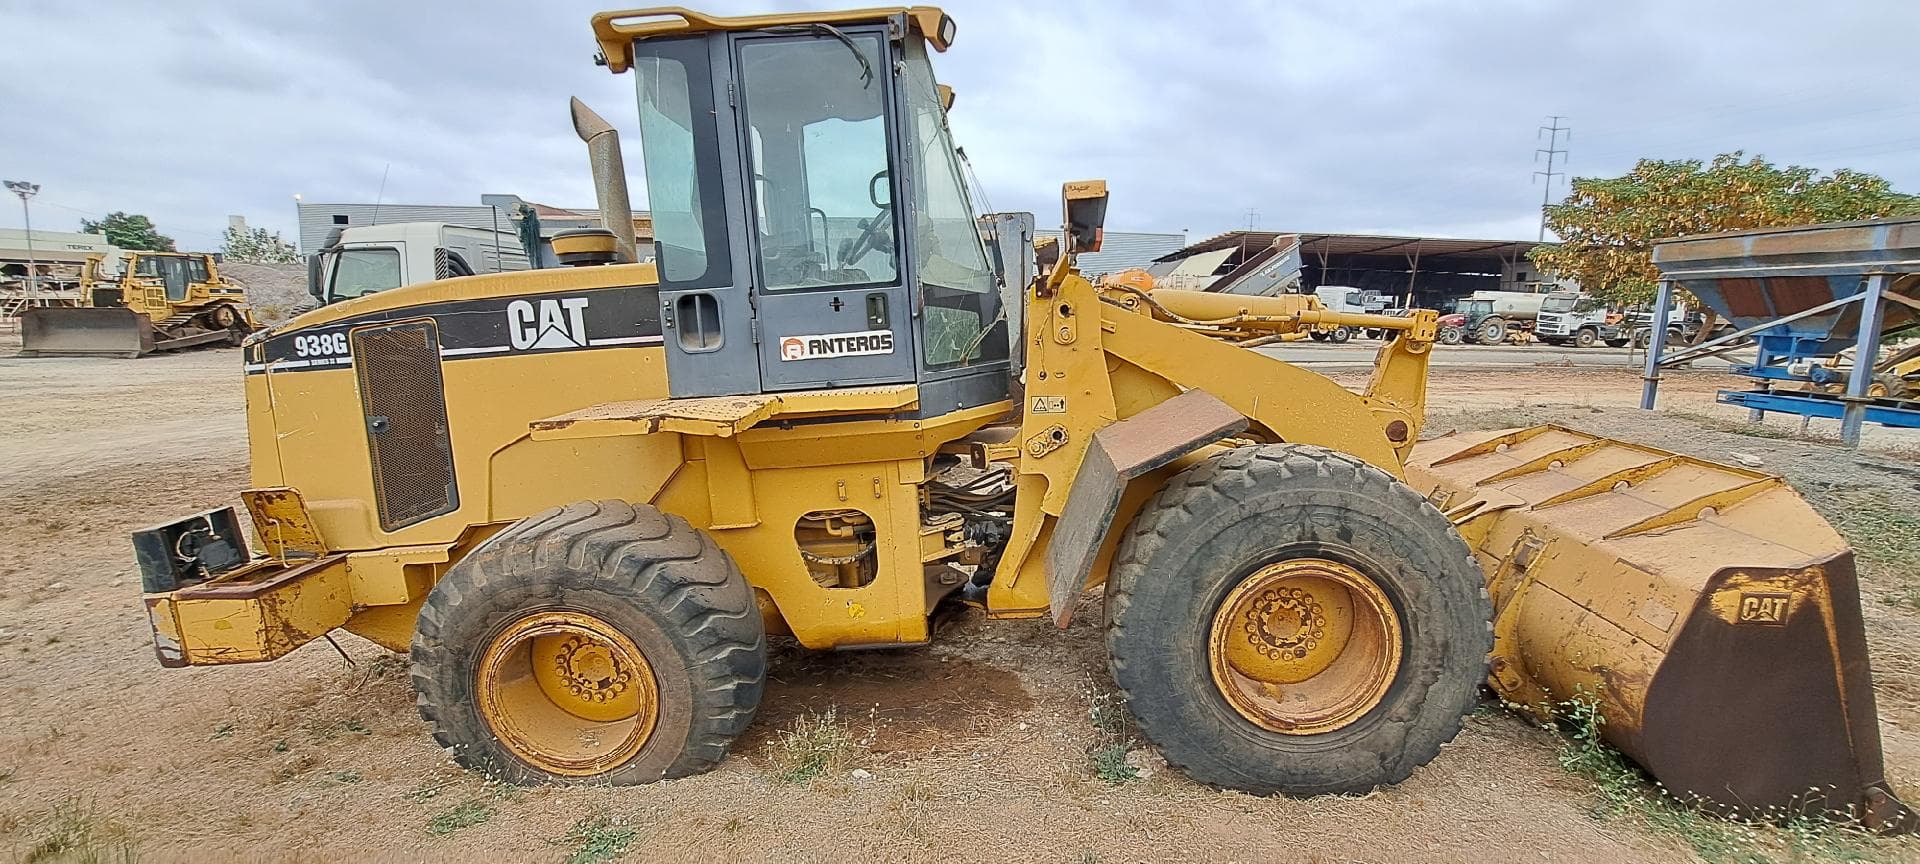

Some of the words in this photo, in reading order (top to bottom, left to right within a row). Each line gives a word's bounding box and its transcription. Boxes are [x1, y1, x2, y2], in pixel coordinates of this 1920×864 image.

[507, 297, 589, 350] CAT
[295, 332, 348, 357] 938G
[808, 334, 893, 355] ANTEROS
[1741, 597, 1788, 621] CAT
